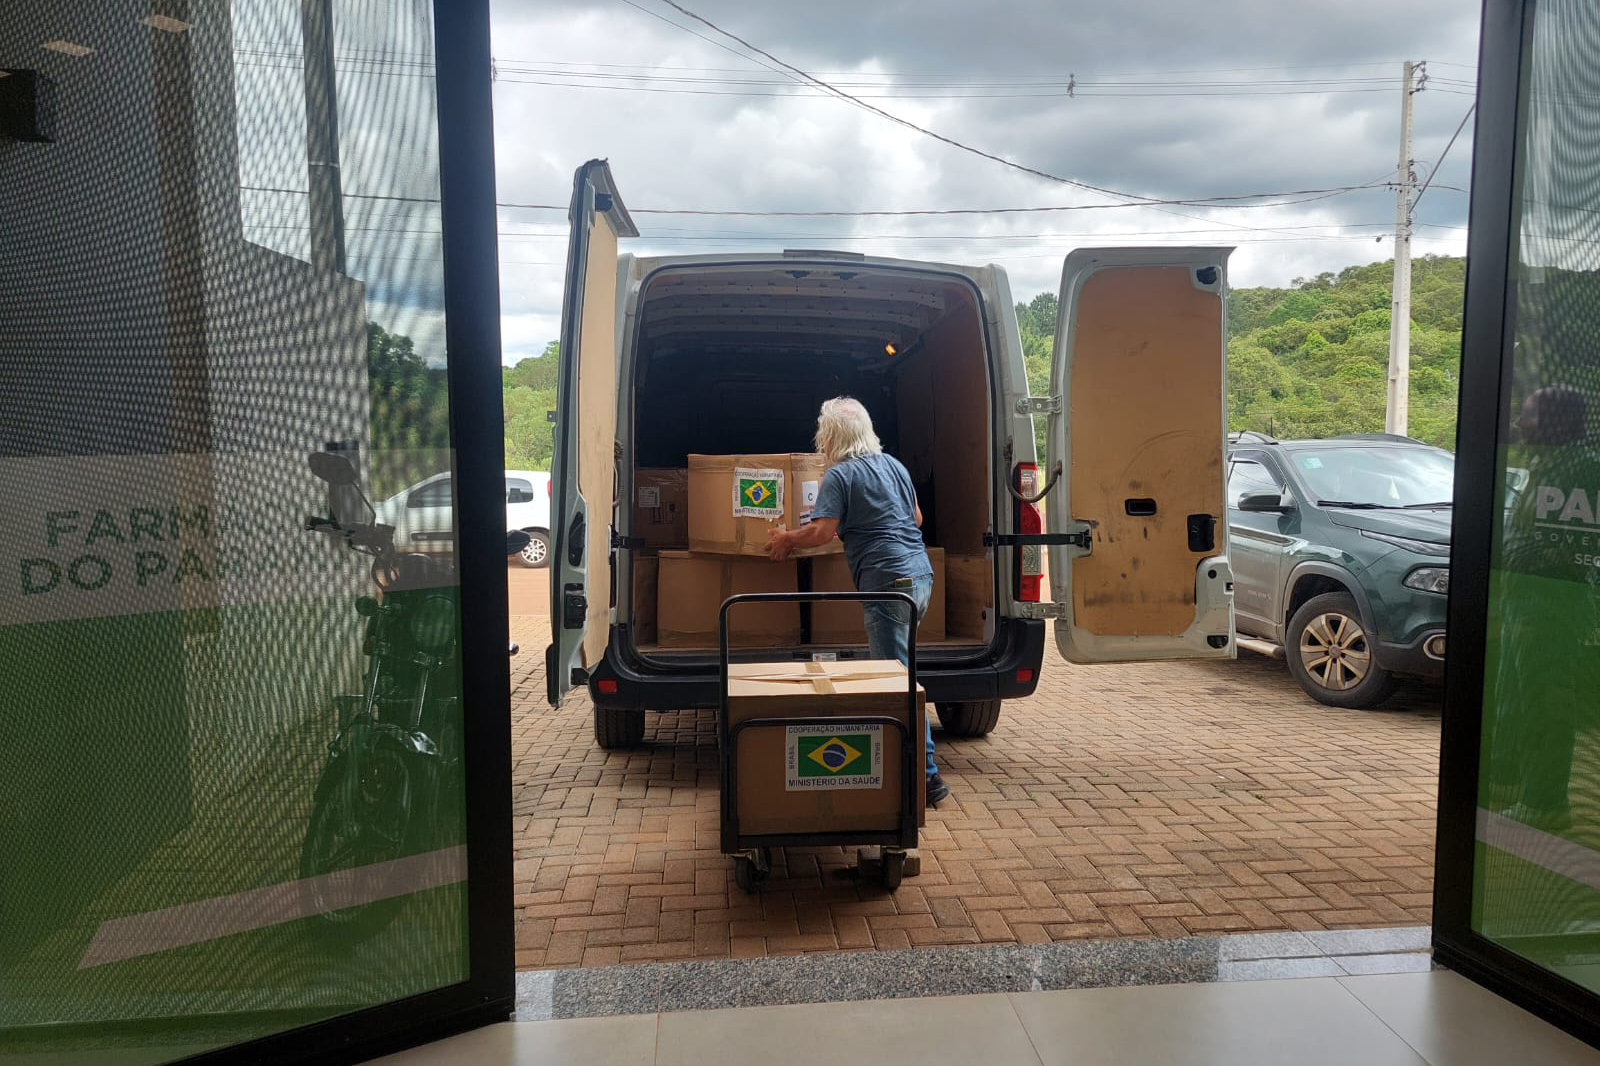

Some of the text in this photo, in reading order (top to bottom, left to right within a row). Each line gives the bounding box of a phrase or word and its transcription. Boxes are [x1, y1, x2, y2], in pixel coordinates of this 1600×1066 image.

[808, 493, 813, 501] C
[1536, 486, 1600, 524] PA
[1535, 531, 1600, 547] GOVE
[20, 554, 113, 596] DO
